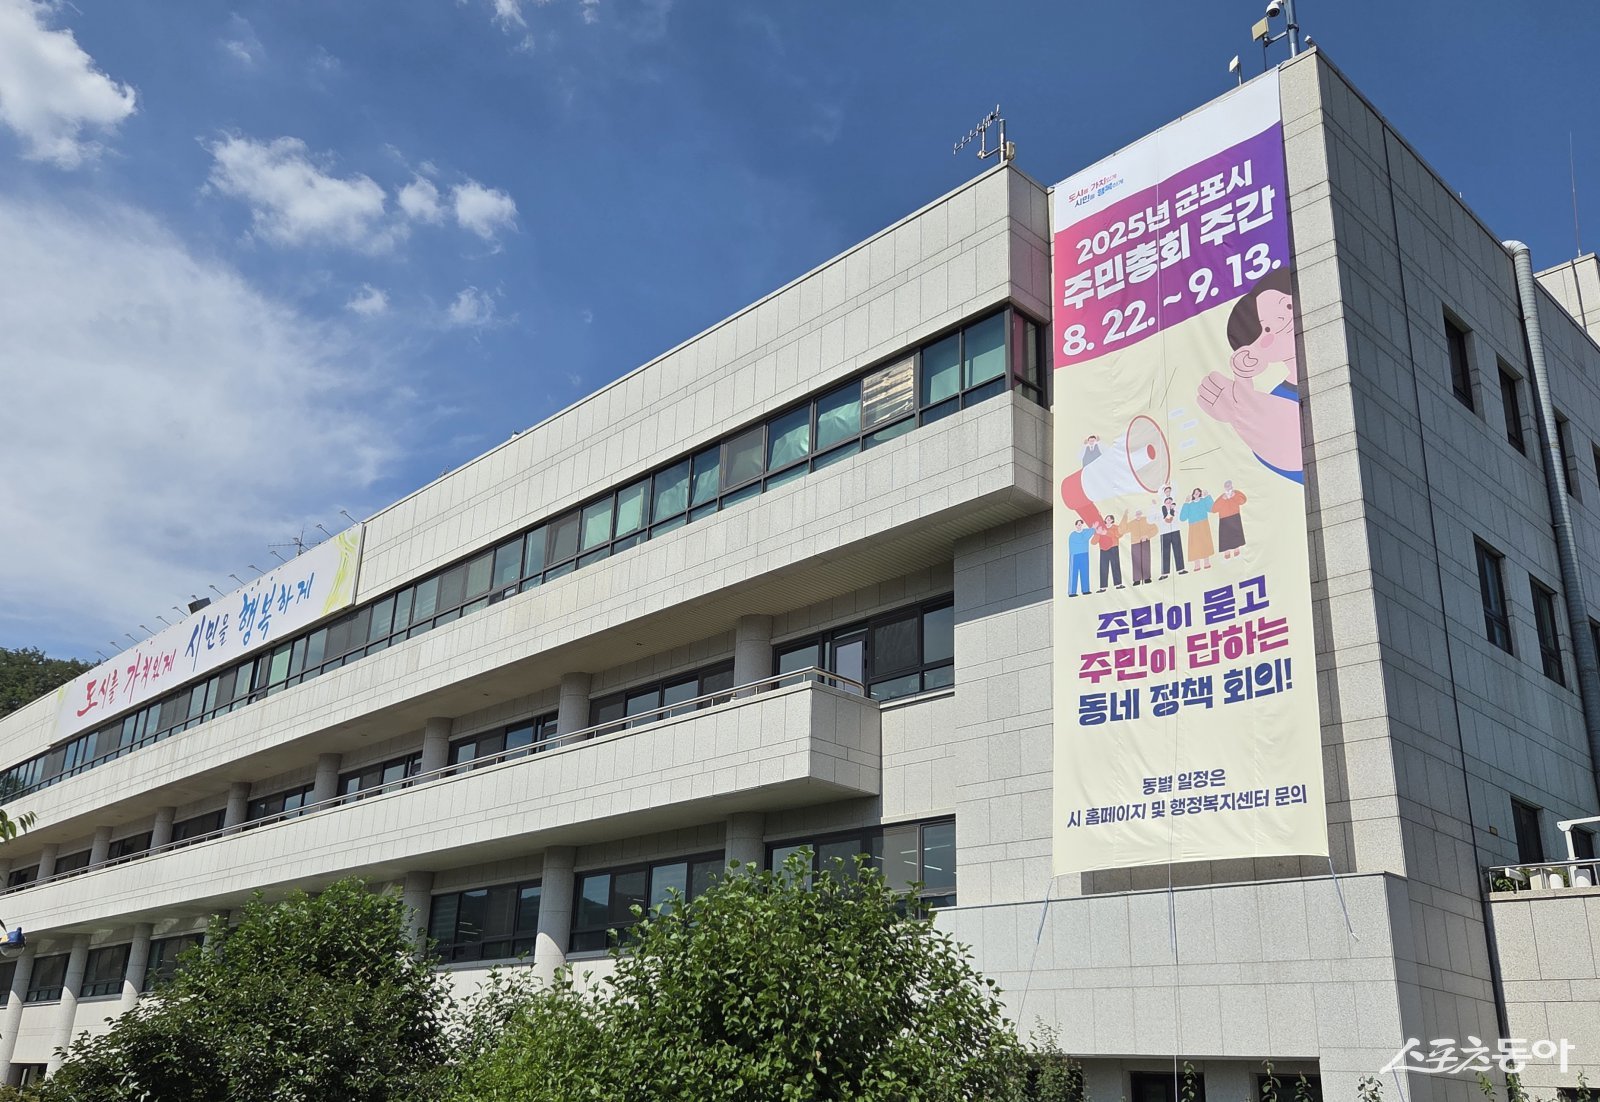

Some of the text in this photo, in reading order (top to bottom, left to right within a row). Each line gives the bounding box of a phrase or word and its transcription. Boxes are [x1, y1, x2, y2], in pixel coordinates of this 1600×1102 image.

[1076, 160, 1253, 264] 2025년 군포시
[1064, 185, 1275, 309] 주민총회 주간
[1063, 243, 1281, 356] 8. 22. ~ 9. 13.
[1097, 575, 1270, 643] 주민이 묻고
[77, 572, 315, 717] 도시를 가치있게 시민을 행복하게
[1079, 616, 1289, 684] 주민이 답하는
[1079, 657, 1293, 726] 동네 정책 회의!
[1067, 784, 1308, 828] 시 홈페이지 및 행정복지센터 문의
[1142, 768, 1226, 795] 동별 일정은
